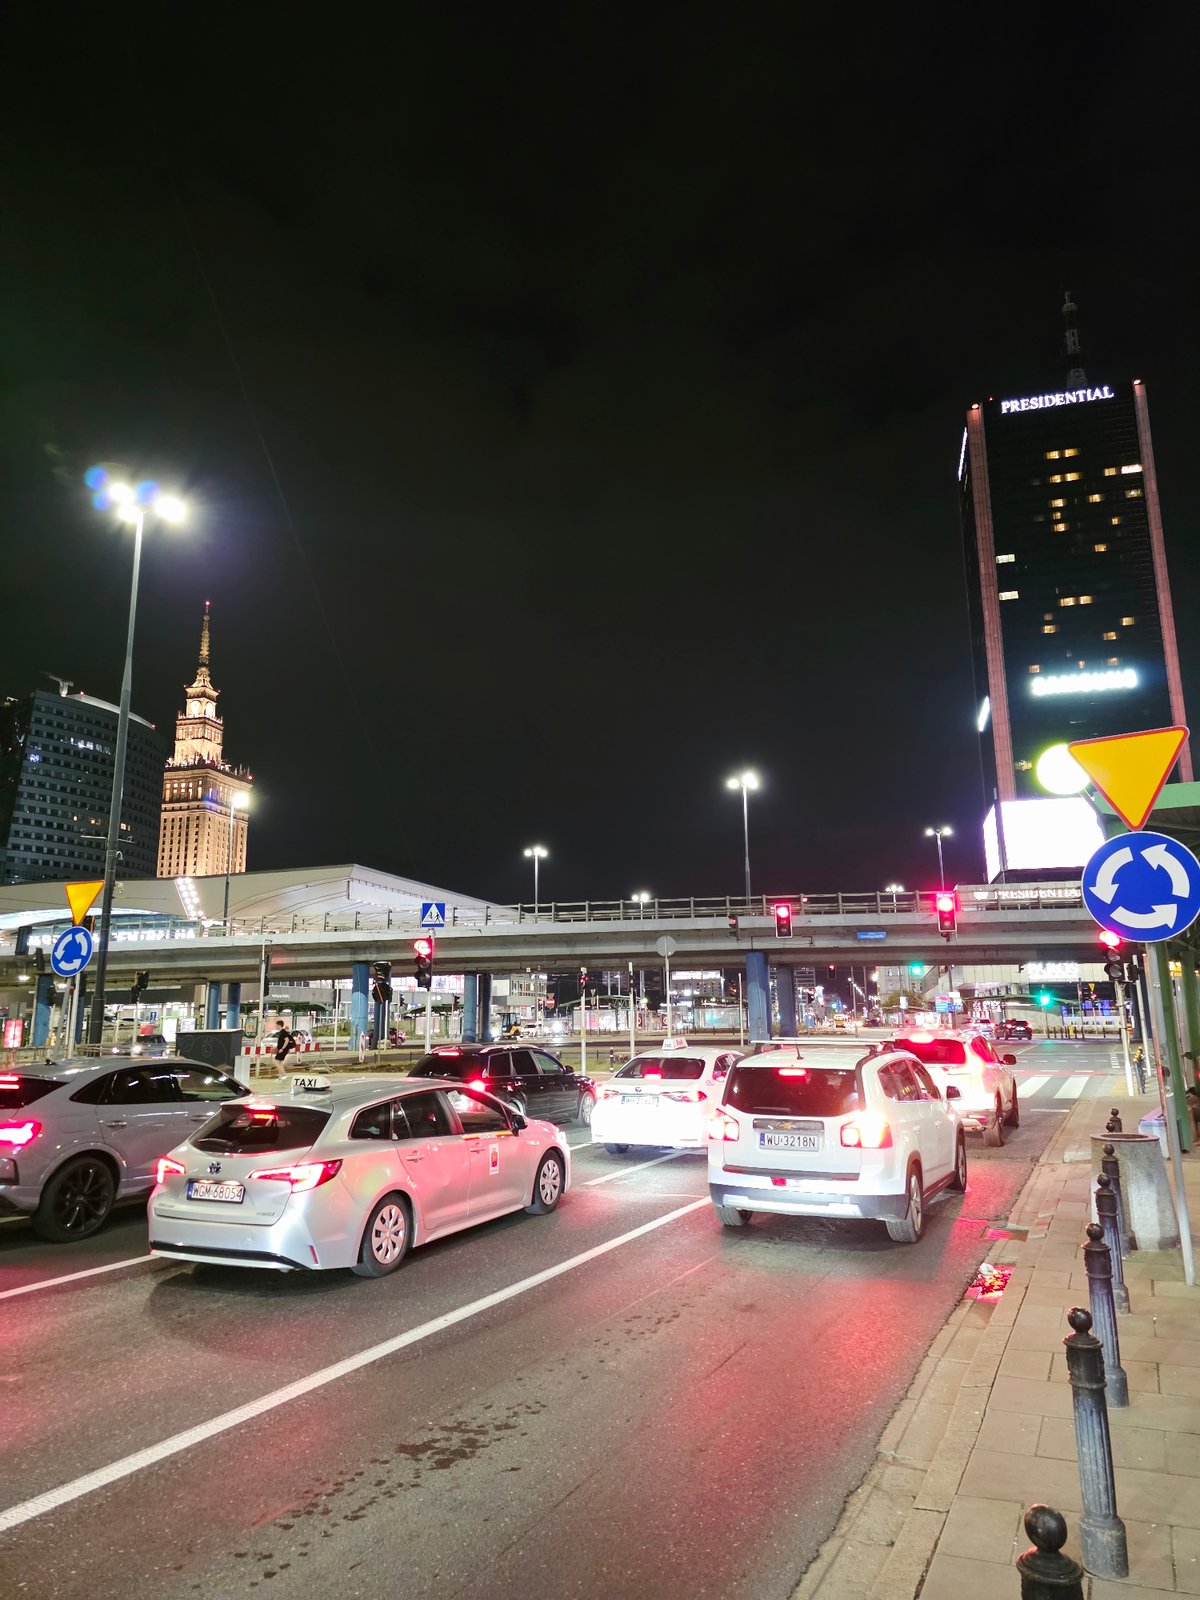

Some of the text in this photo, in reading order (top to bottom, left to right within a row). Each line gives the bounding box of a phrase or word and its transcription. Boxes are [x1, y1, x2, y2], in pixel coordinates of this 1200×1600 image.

[1001, 385, 1115, 414] PRESIDENTIAL
[294, 1078, 317, 1087] TAXI
[767, 1134, 816, 1148] WU 3218N
[212, 1185, 243, 1200] 68054
